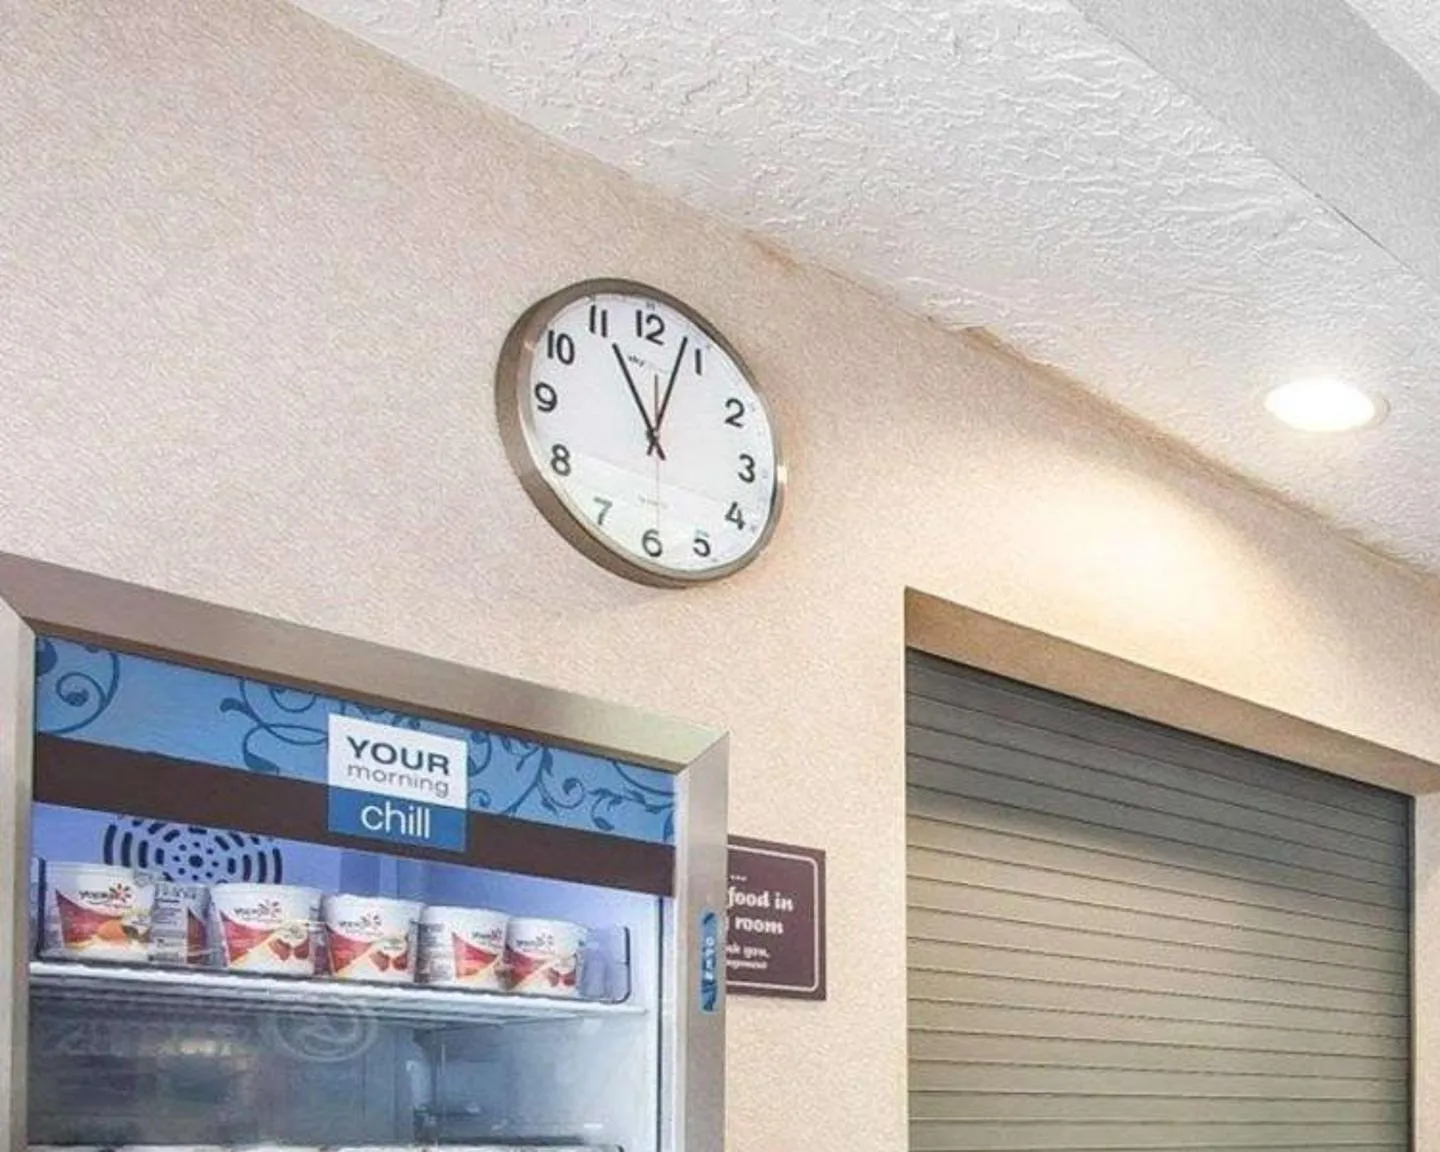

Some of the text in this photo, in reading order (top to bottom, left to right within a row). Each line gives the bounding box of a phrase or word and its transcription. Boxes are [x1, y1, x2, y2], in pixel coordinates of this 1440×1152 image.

[589, 304, 609, 338] 11
[635, 309, 665, 346] 12
[547, 329, 575, 366] 10
[694, 348, 702, 376] 1
[533, 382, 558, 413] 9
[724, 397, 746, 428] 2
[550, 443, 571, 477] 8
[738, 454, 756, 484] 3
[593, 496, 613, 526] 7
[724, 501, 747, 530] 4
[642, 529, 664, 558] 6
[693, 531, 712, 558] 5
[346, 736, 450, 776] YOUR
[347, 764, 449, 799] morning
[361, 801, 430, 839] chill
[727, 886, 793, 912] food in
[735, 916, 784, 935] room
